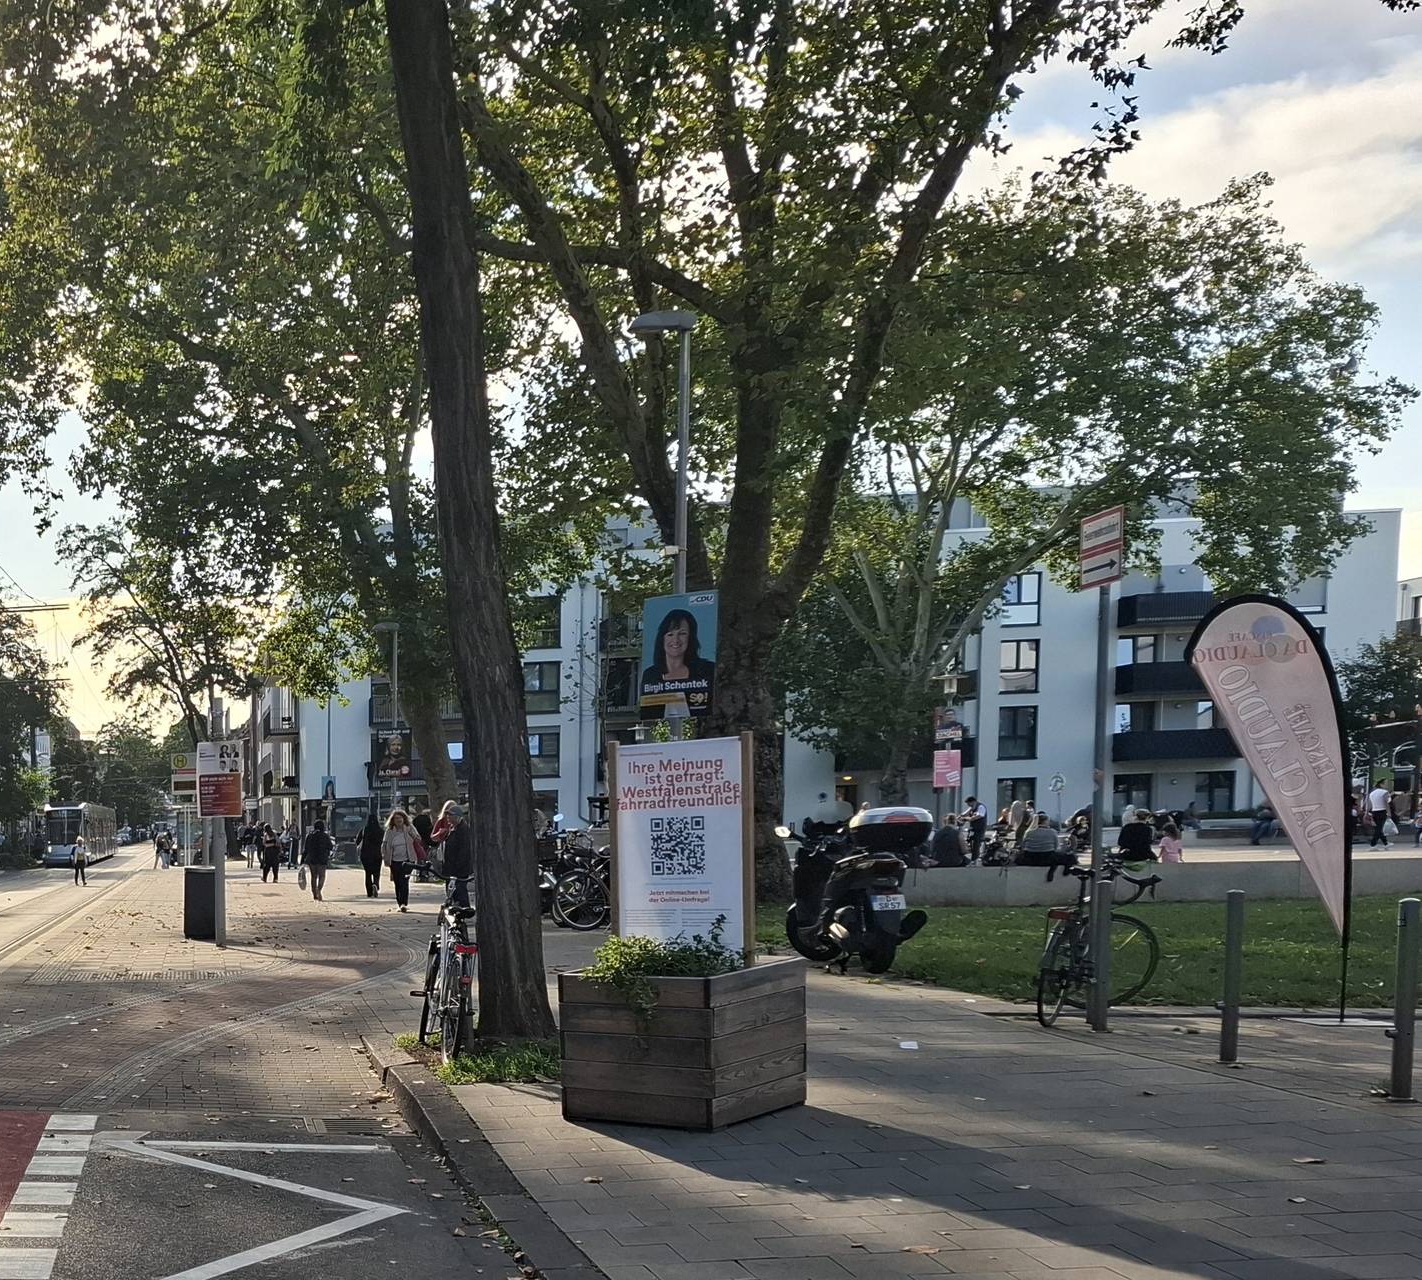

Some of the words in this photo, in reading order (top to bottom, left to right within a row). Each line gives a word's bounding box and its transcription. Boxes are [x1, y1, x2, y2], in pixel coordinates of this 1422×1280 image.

[695, 595, 714, 603] CDU
[644, 683, 664, 693] Birgit
[628, 762, 655, 774] Ihre
[659, 758, 723, 771] Meinung
[645, 772, 661, 785] ist
[665, 768, 724, 786] gefragt:
[622, 780, 740, 799] Westfalenstraße
